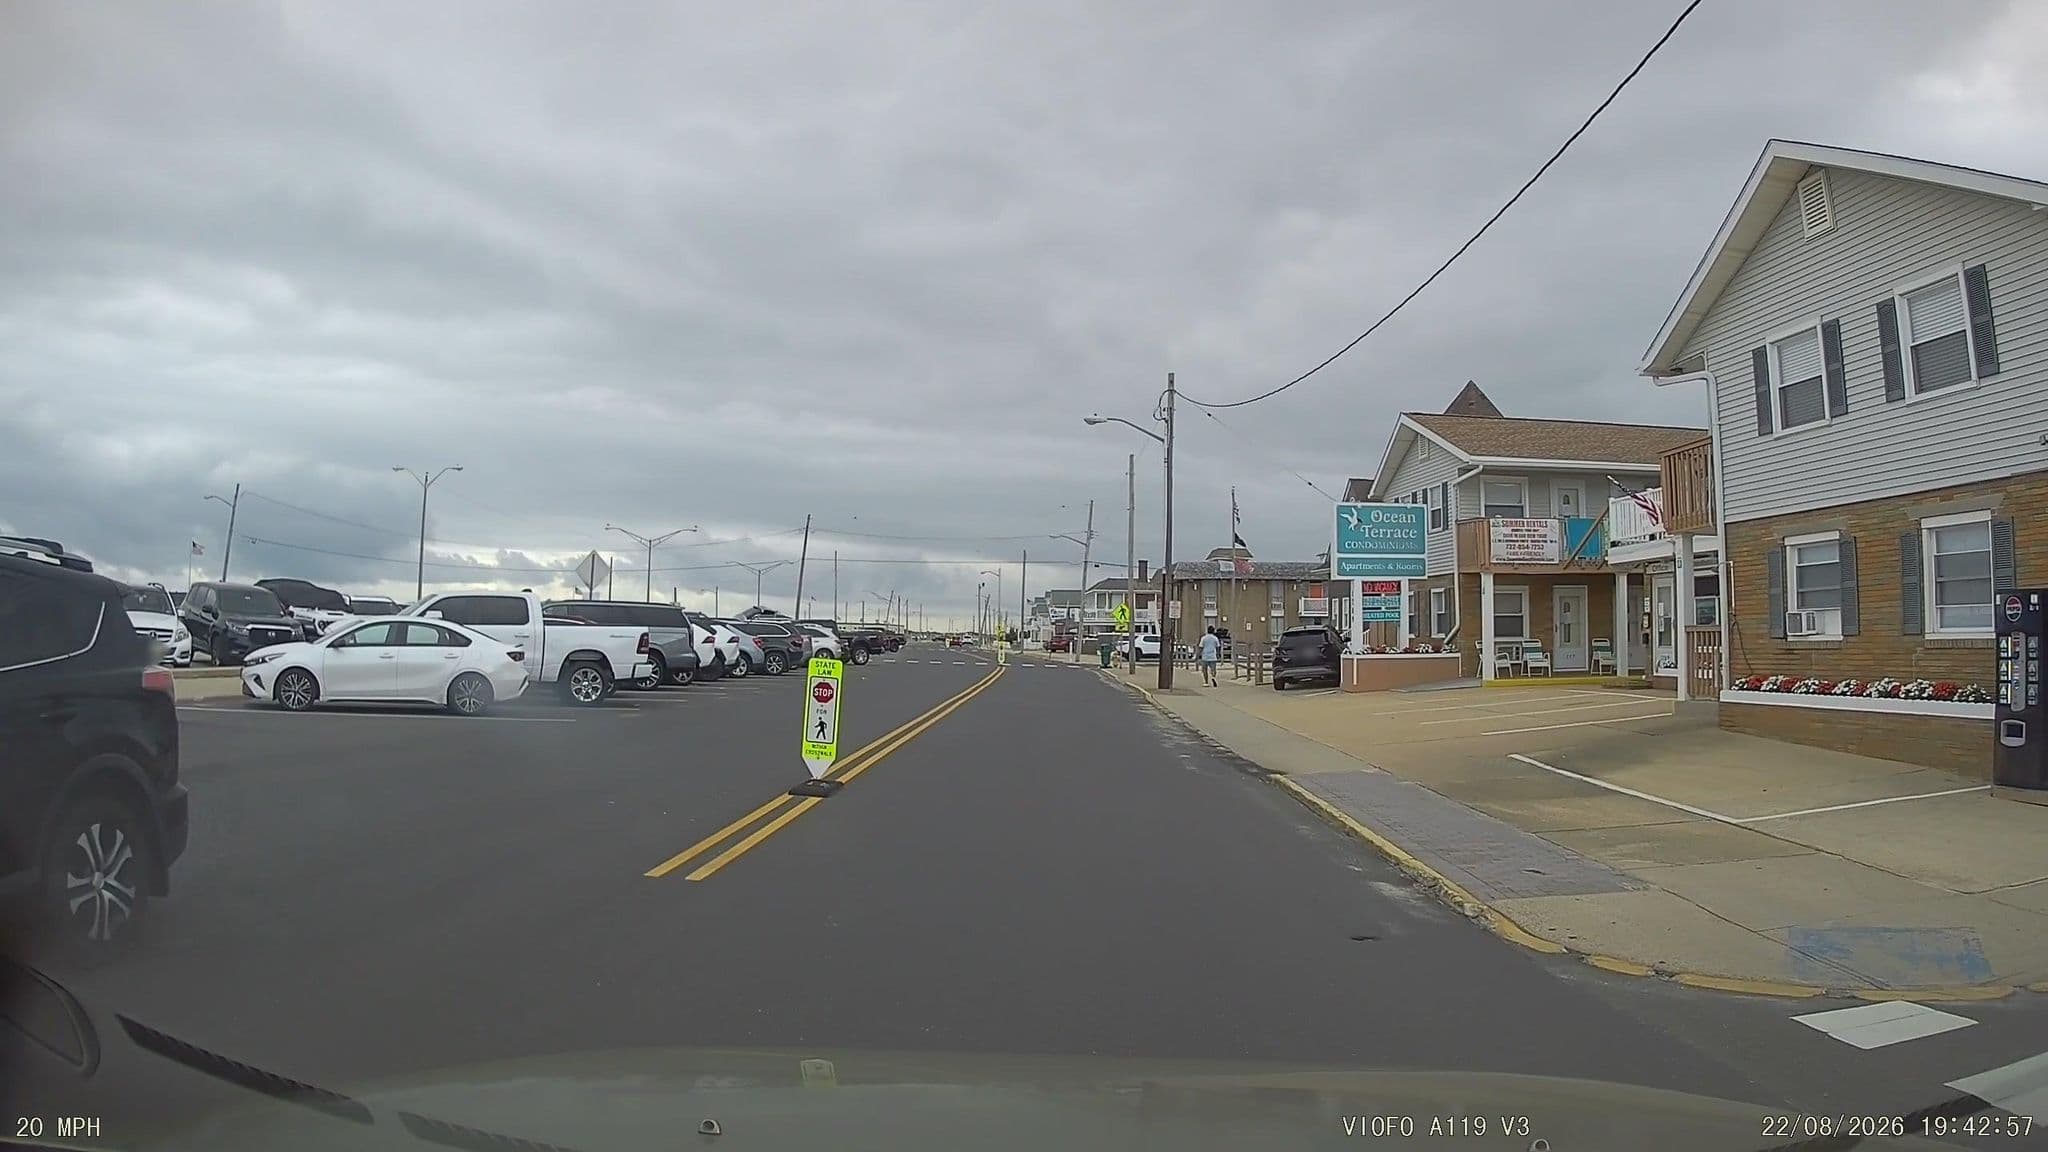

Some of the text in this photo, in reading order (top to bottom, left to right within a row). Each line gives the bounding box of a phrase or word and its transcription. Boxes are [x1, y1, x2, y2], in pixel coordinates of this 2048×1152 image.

[1370, 510, 1416, 523] Ocean
[1526, 520, 1548, 528] RENTALS
[1360, 524, 1418, 538] Terrace
[1345, 541, 1418, 549] CONDOMINIUMS
[1341, 562, 1386, 572] Apartments
[1396, 562, 1423, 570] Rooms
[815, 661, 836, 669] STATE
[814, 688, 833, 697] STOP
